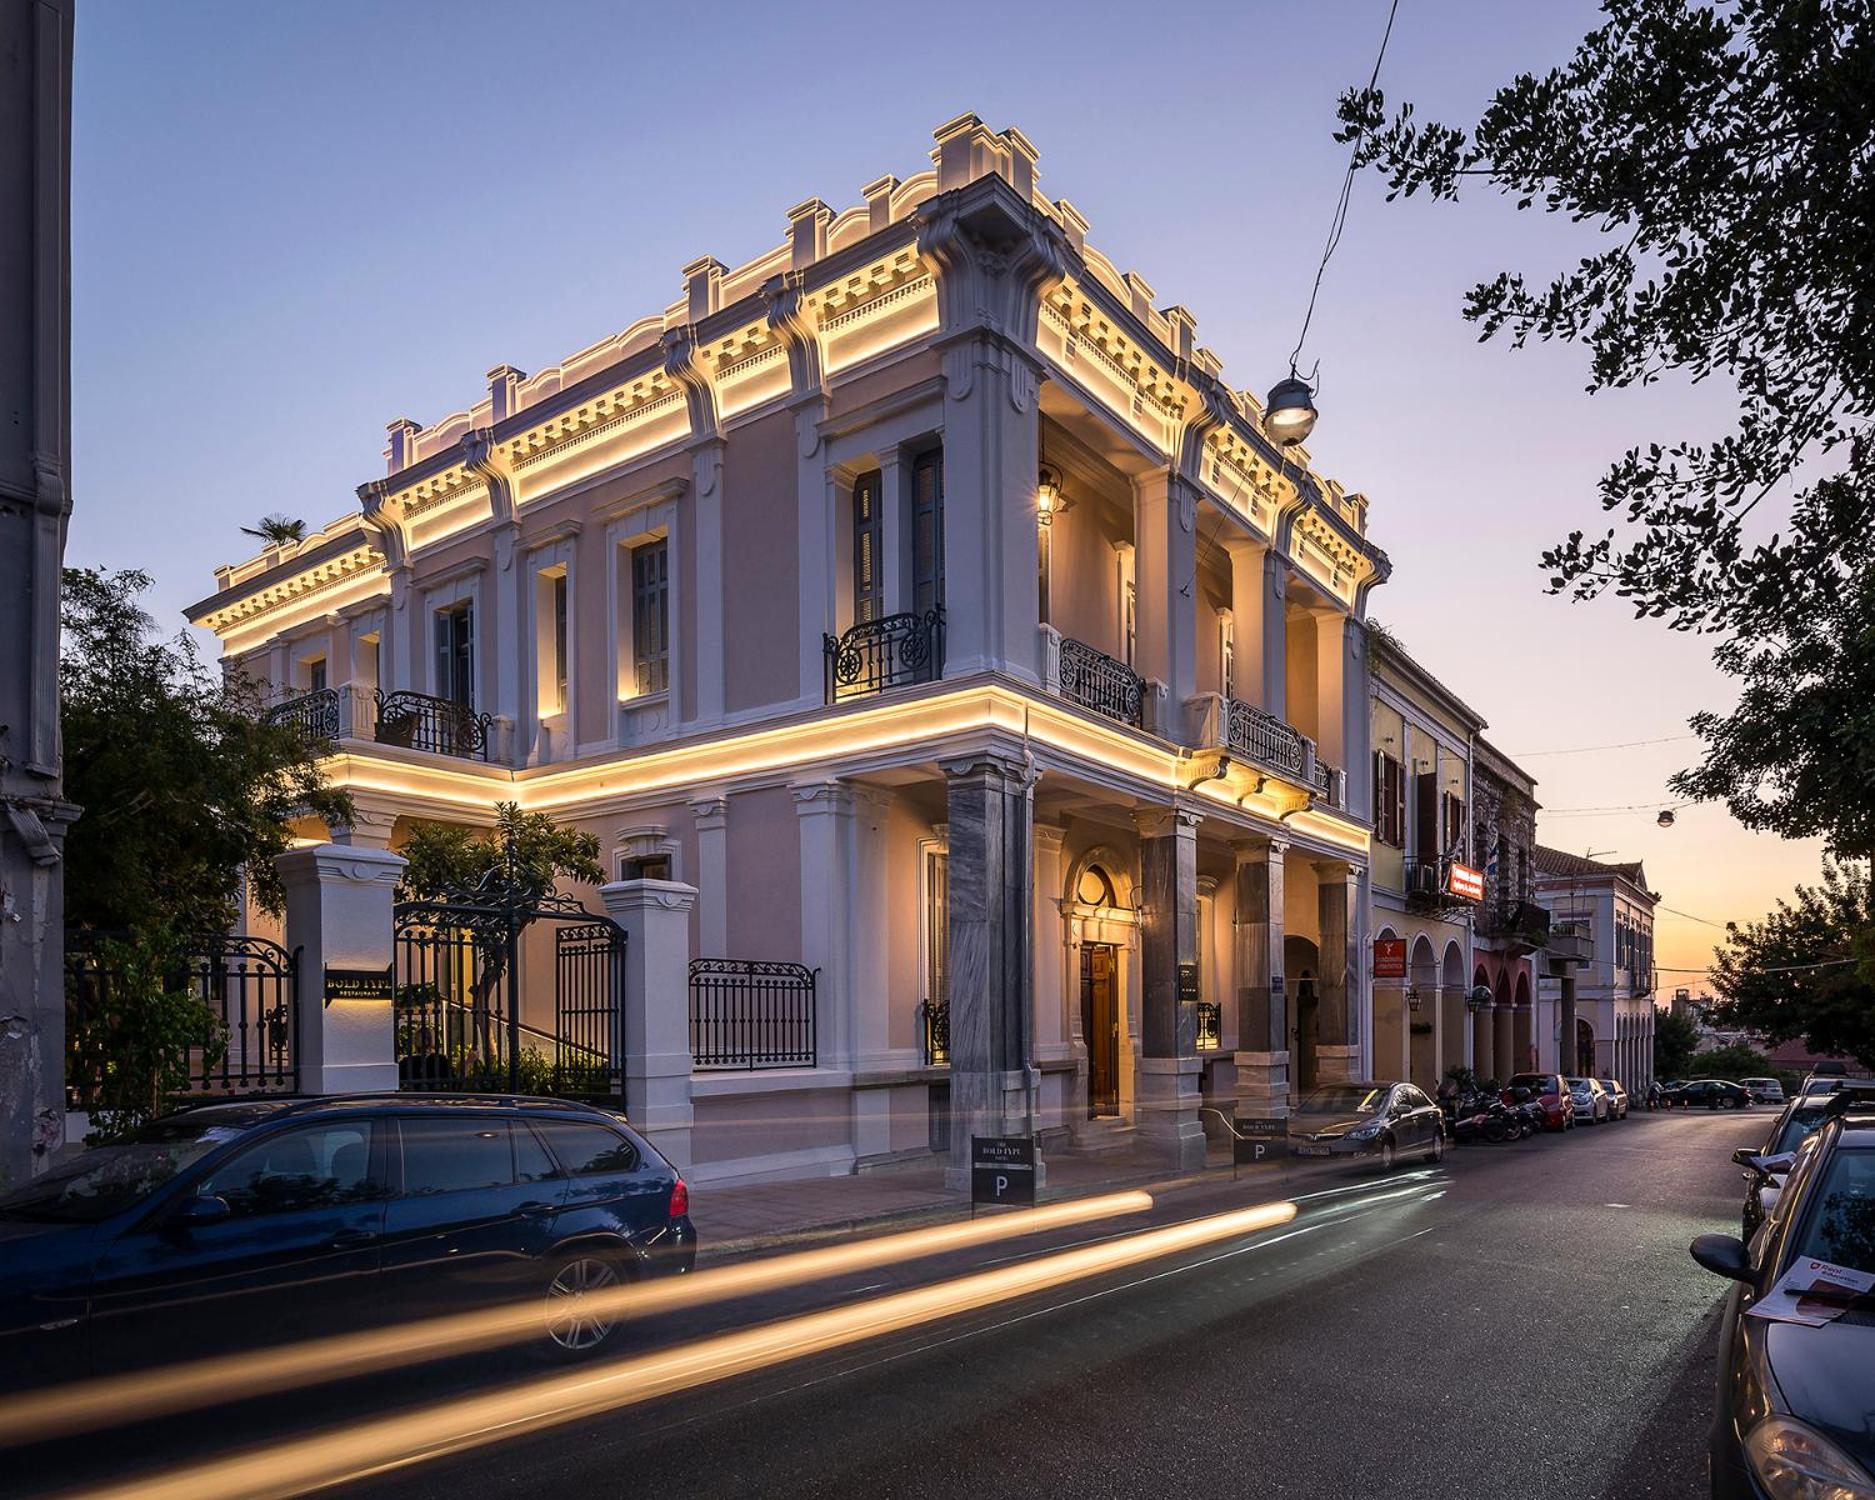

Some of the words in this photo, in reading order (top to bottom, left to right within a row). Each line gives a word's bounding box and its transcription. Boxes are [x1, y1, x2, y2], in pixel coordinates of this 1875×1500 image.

[327, 979, 360, 989] BOLD
[364, 979, 392, 989] TYPE
[1255, 1144, 1265, 1159] P
[996, 1175, 1008, 1197] P
